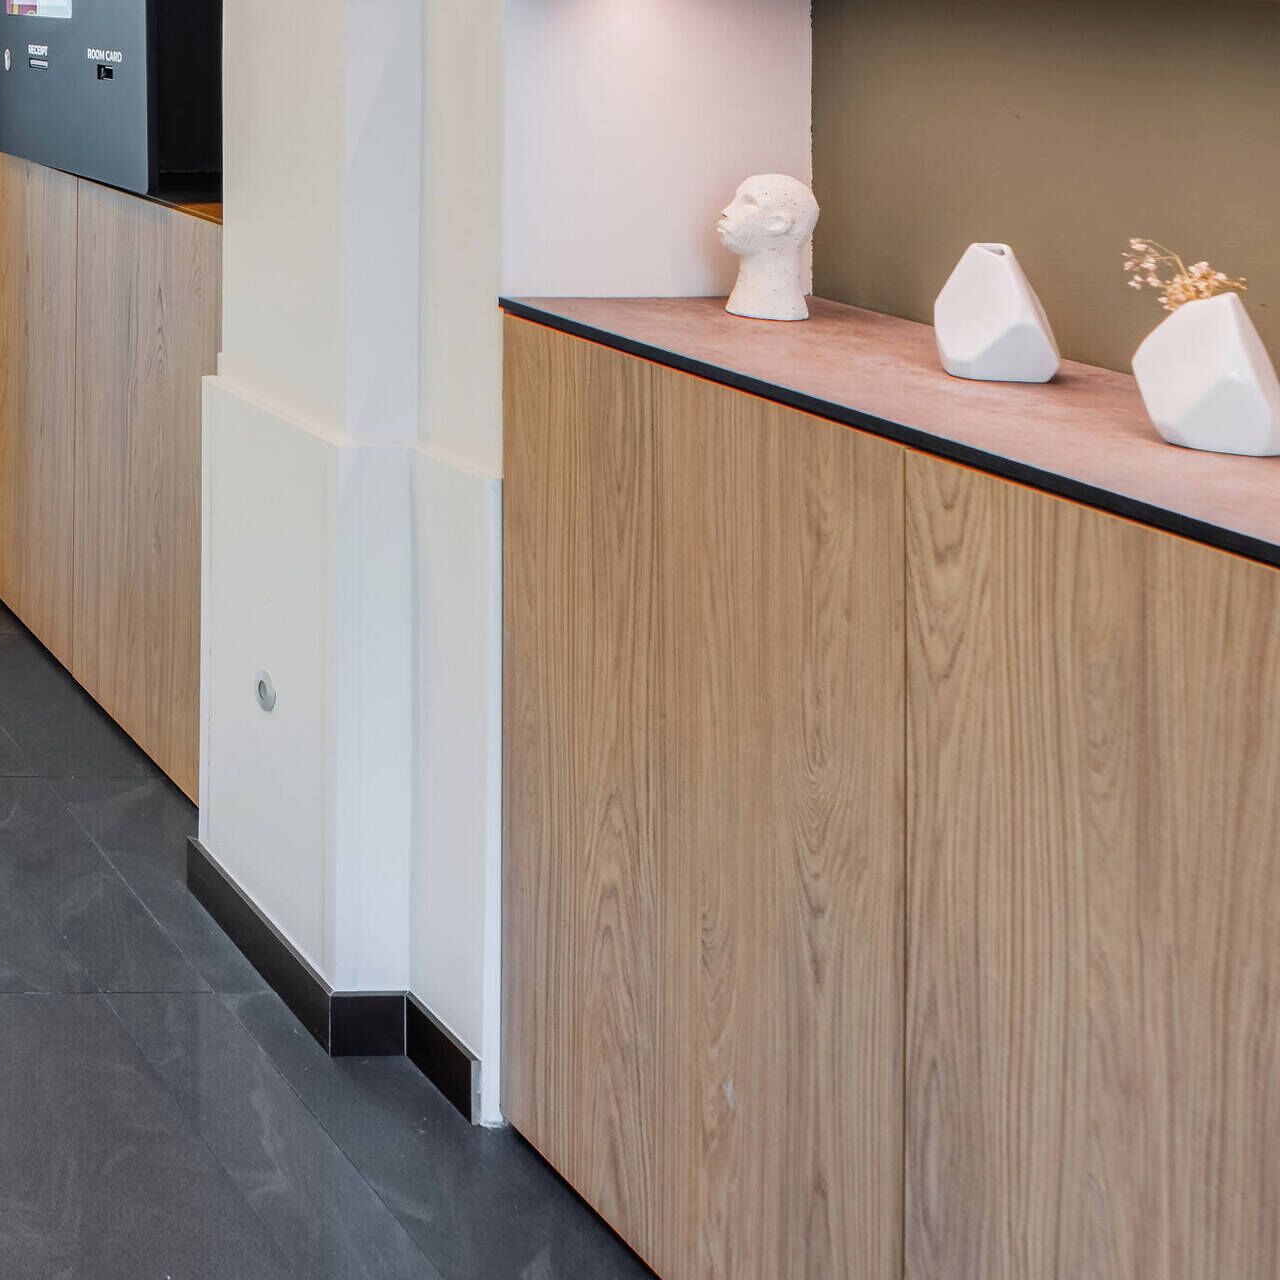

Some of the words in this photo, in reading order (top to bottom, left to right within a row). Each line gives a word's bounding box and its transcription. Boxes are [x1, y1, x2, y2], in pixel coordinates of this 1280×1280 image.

[28, 44, 48, 56] RECEIPT
[87, 48, 105, 60] ROOM
[105, 50, 122, 63] CARD
